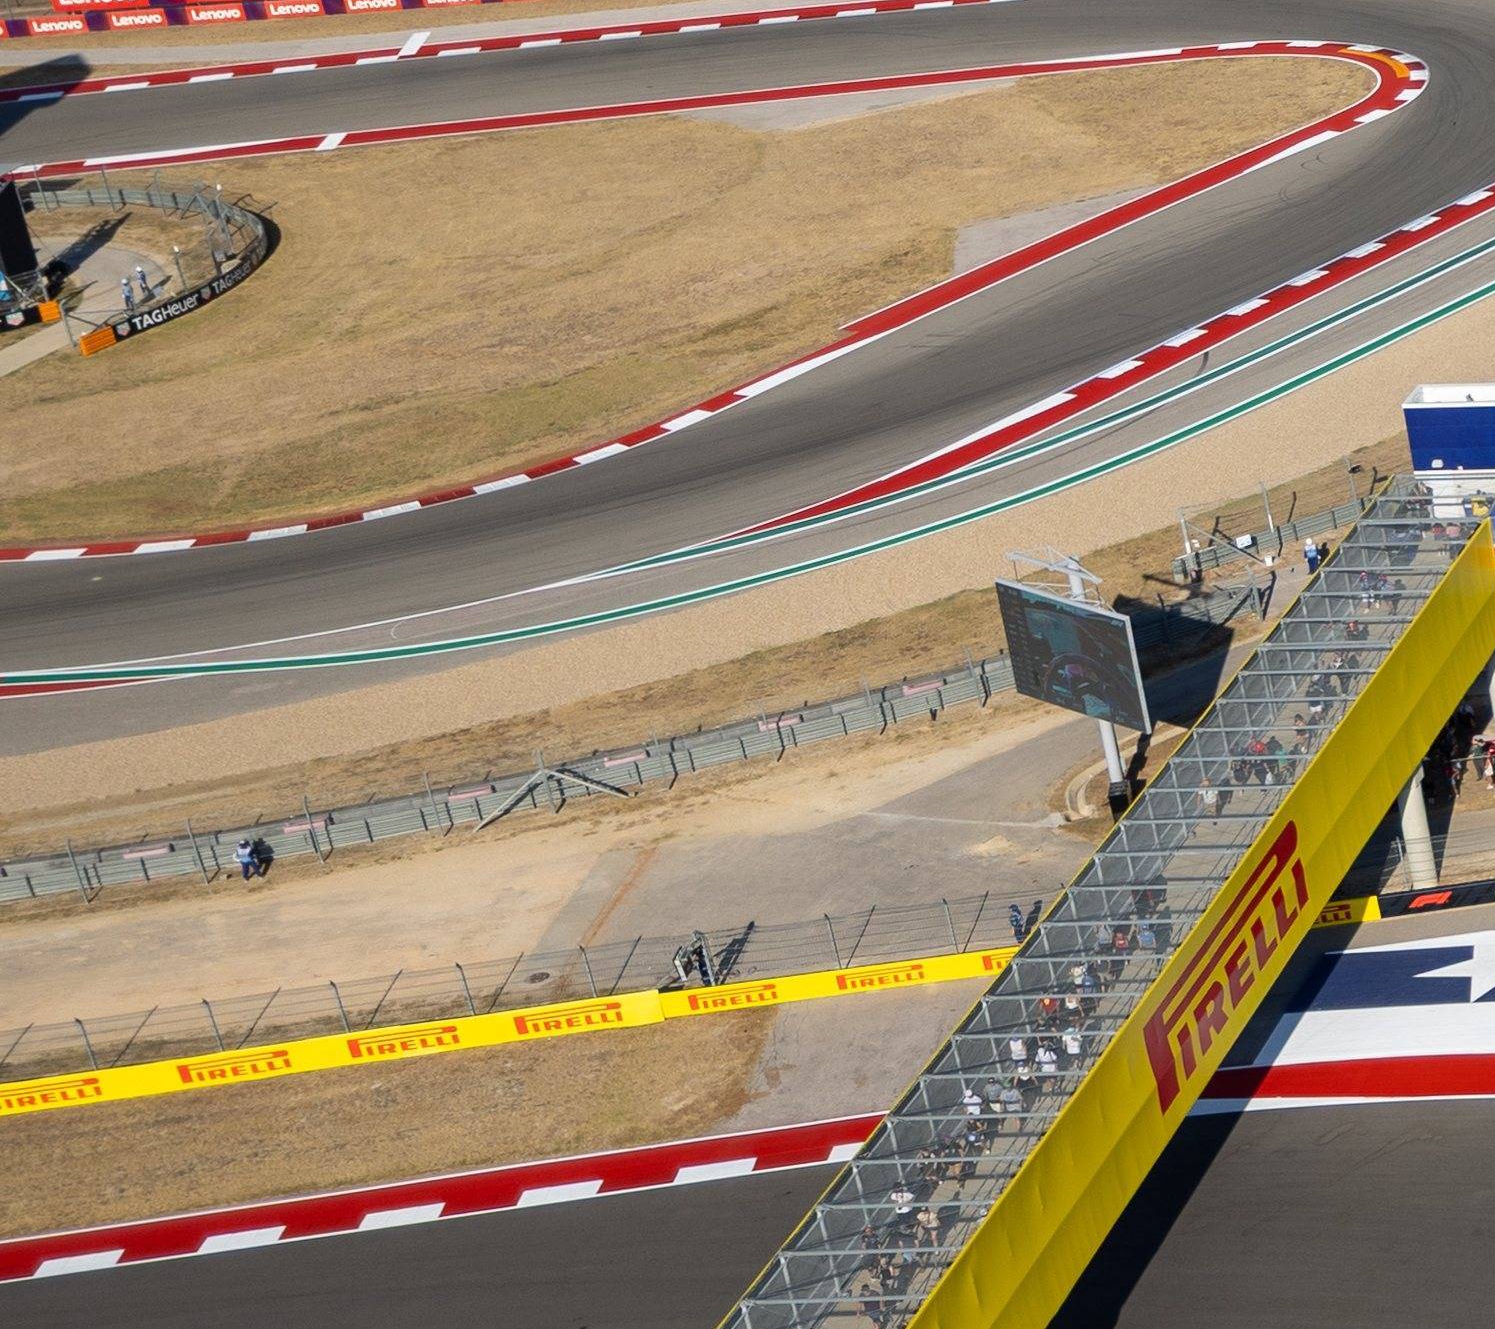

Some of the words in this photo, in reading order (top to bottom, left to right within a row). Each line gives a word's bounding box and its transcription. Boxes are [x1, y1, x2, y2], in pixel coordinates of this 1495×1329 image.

[111, 11, 163, 28] Lenovo
[190, 6, 241, 22] Lenovo
[269, 1, 321, 17] Lenovo
[31, 17, 84, 33] Lenovo
[836, 963, 926, 992] PIRELLI
[1143, 820, 1309, 1116] PIRELLI
[687, 983, 778, 1012] PIRELLI
[513, 1001, 623, 1037] PIRELLI
[347, 1025, 461, 1060] PIRELLI
[177, 1050, 292, 1086] PIRELLI
